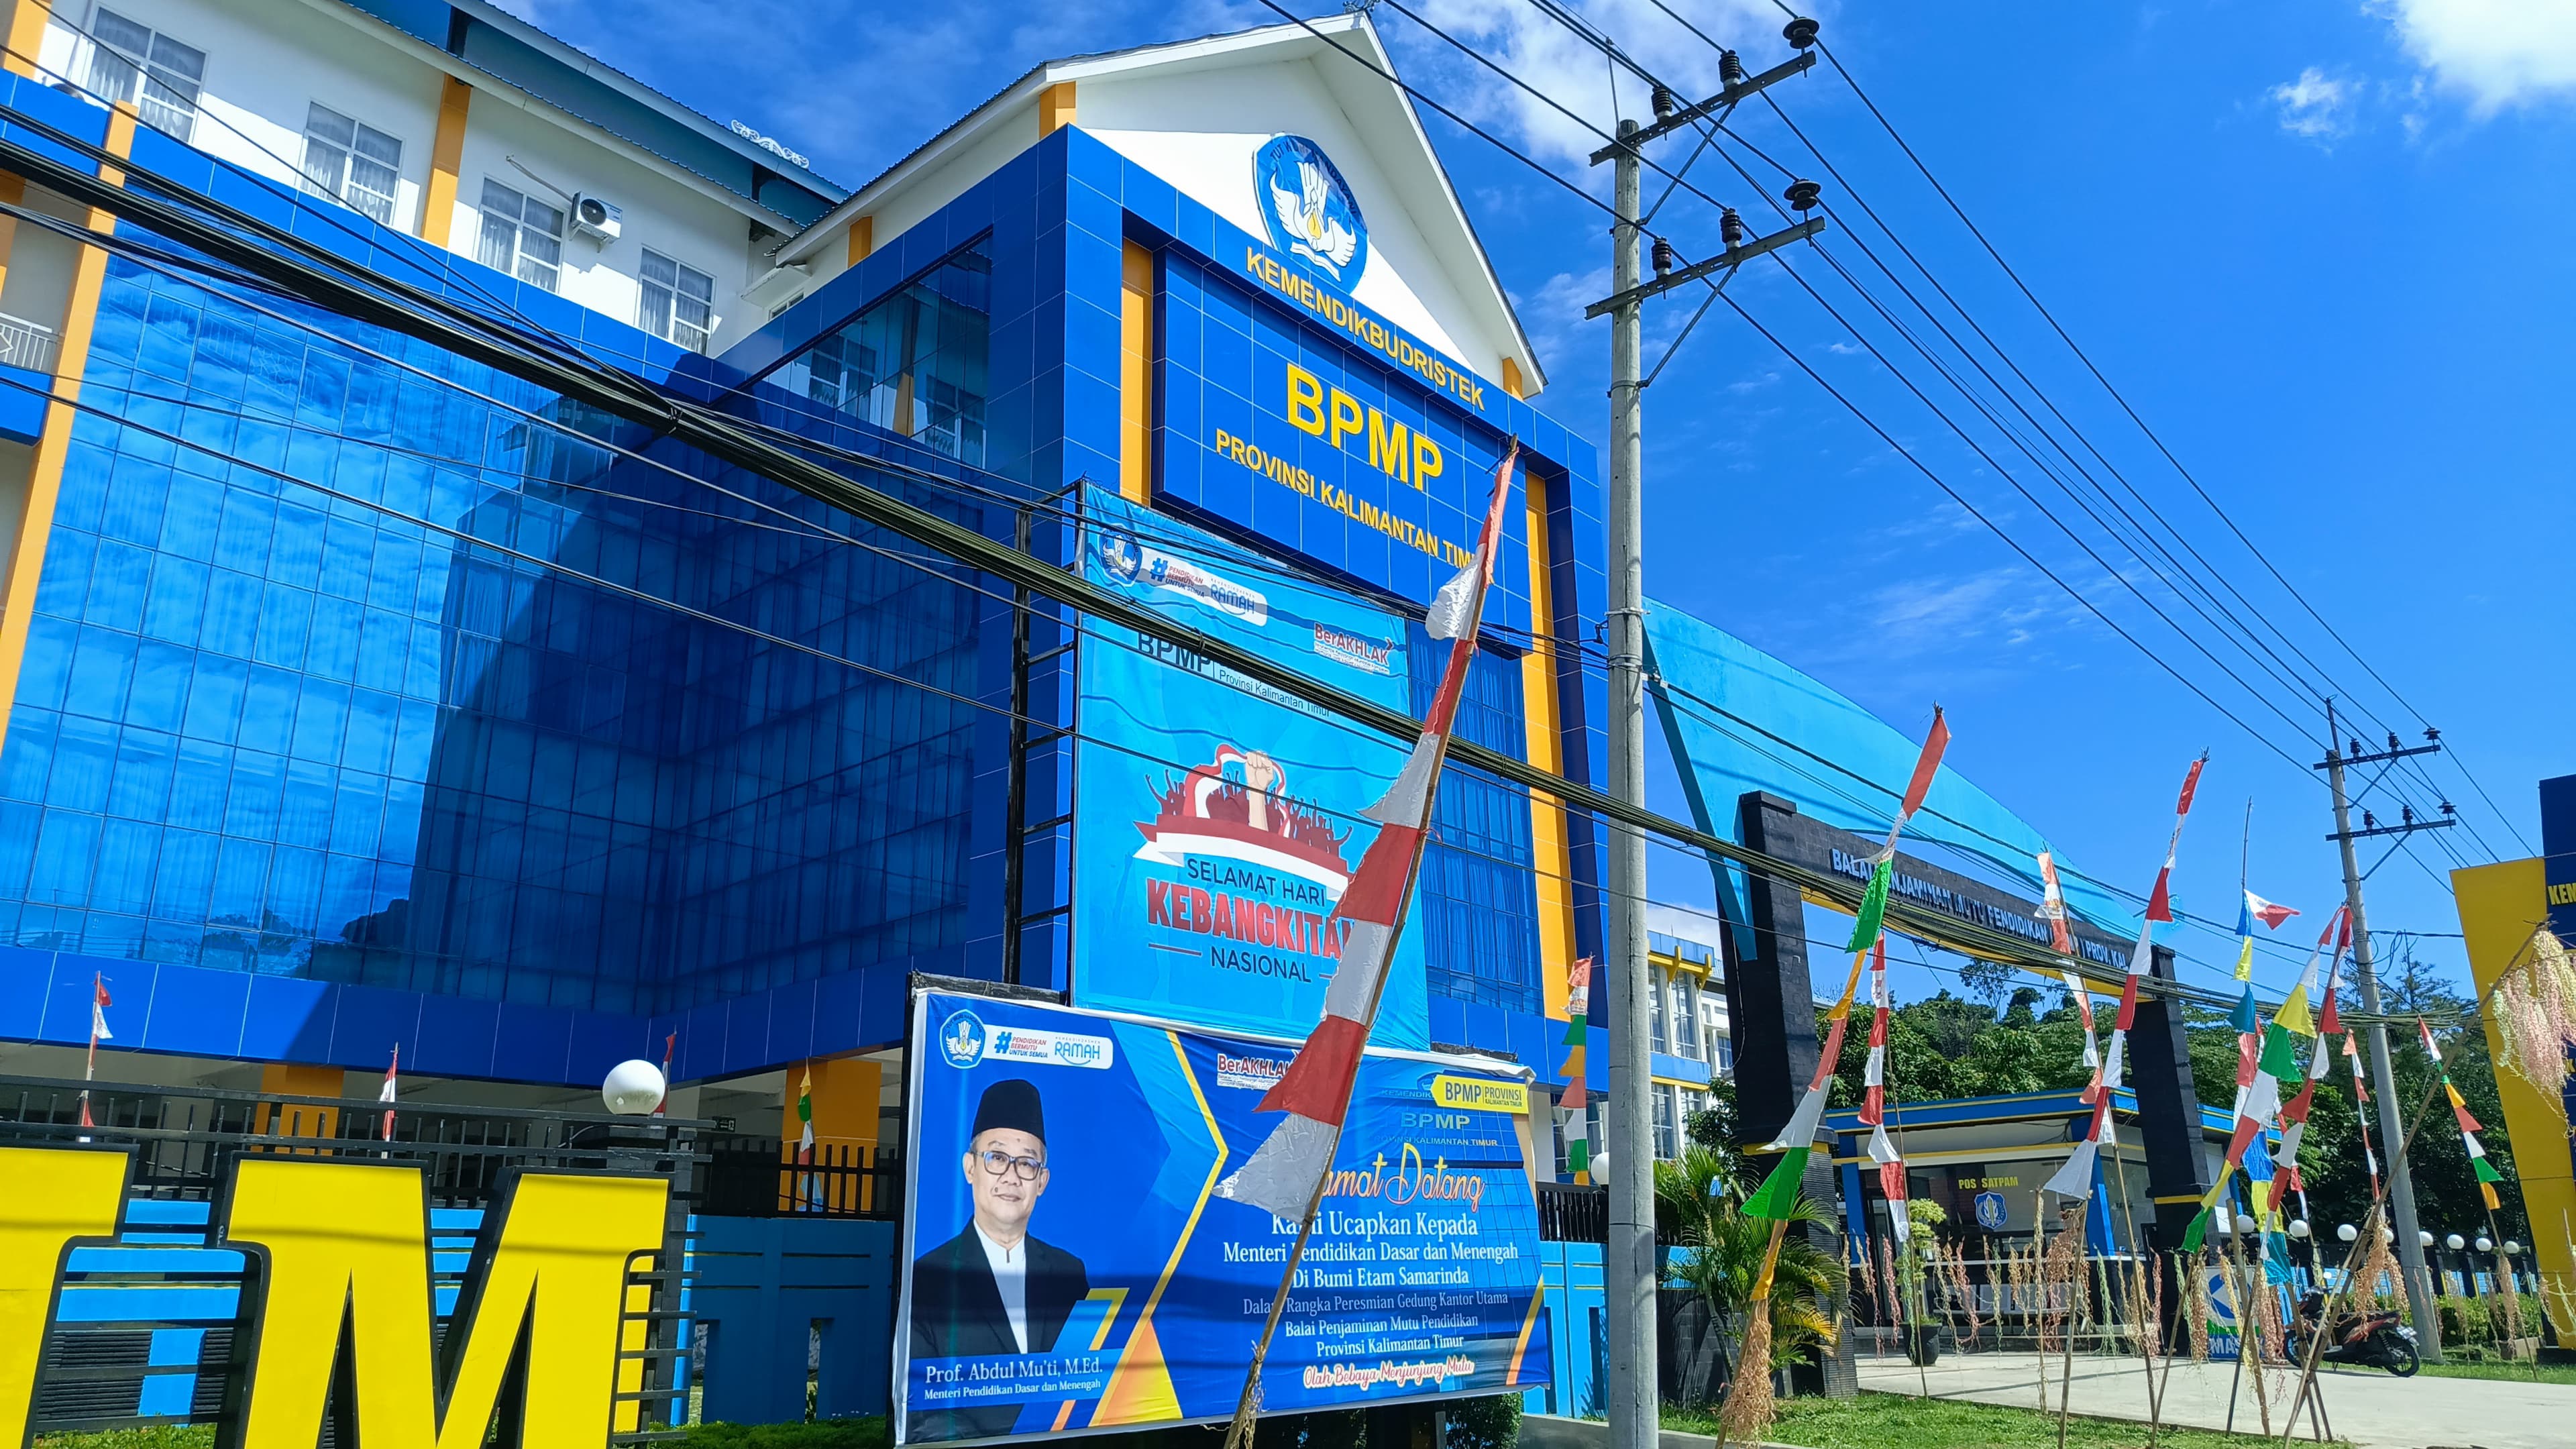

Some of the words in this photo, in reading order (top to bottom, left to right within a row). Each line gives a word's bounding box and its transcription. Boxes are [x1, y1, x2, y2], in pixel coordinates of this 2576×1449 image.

[1246, 246, 1485, 411] KEMENDIKBUDRISTEK
[1287, 363, 1443, 492] BPMP
[1216, 428, 1315, 498] PROVINSI
[1321, 480, 1438, 557] KALIMANTAN
[1165, 578, 1185, 590] UNTUK
[1169, 566, 1203, 584] PENDIDIKAN
[1210, 584, 1255, 615] RAMAH
[1138, 631, 1211, 672] BPMP
[1315, 623, 1389, 666] BerAKHLAK
[1220, 669, 1253, 692] Provinsi
[1255, 680, 1303, 709] Kalimantan
[1187, 858, 1276, 896] SELAMAT
[1282, 879, 1326, 907] HARI
[1987, 904, 2048, 947] PENDIDIKAN
[2085, 940, 2111, 965] PROV.
[1211, 946, 1311, 983] NASIONAL
[1011, 1042, 1037, 1051] BERMUTU
[1012, 1036, 1046, 1045] PENDIDIKAN
[1055, 1041, 1099, 1065] RAMAH
[1381, 1089, 1433, 1099] KEMENDIK
[1446, 1082, 1481, 1104] BPMP
[1485, 1086, 1521, 1101] PROVINSI
[1401, 1112, 1470, 1130] BPMP
[1414, 1138, 1468, 1146] KALIMANTAN
[1470, 1138, 1498, 1146] TIMUR
[1322, 1152, 1385, 1198] amat
[1385, 1142, 1485, 1213] Datang
[1959, 1179, 1977, 1189] POS
[1981, 1176, 2019, 1188] SATPAM
[1329, 1211, 1410, 1242] Ucapkan
[1416, 1212, 1479, 1242] Kepada
[1224, 1242, 1287, 1262] Menteri
[1380, 1242, 1420, 1260] Dasar
[1423, 1242, 1448, 1260] dan
[1450, 1242, 1519, 1265] Menengah
[1292, 1269, 1309, 1288] Di
[1313, 1268, 1353, 1288] Bumi
[1357, 1267, 1395, 1287] Etam
[1399, 1266, 1469, 1285] Samarinda
[1287, 1295, 1332, 1317] Rangka
[1334, 1294, 1395, 1311] Peresmian
[1397, 1293, 1437, 1311] Gedung
[1439, 1291, 1474, 1307] Kantor
[1476, 1291, 1509, 1305] Utama
[1285, 1320, 1316, 1337] Balai
[1319, 1318, 1387, 1339] Penjaminan
[1390, 1316, 1419, 1331] Mutu
[1421, 1312, 1478, 1330] Pendidikan
[1316, 1339, 1365, 1357] Provinsi
[1368, 1336, 1430, 1354] Kalimantan
[1432, 1334, 1464, 1349] Timur
[925, 1363, 964, 1383] Prof.
[969, 1362, 1014, 1381] Abdul
[1065, 1356, 1103, 1374] M.Ed.
[1304, 1364, 1334, 1387] Olah
[1334, 1363, 1377, 1389] Bebaya
[1380, 1360, 1444, 1385] Menjunjung
[1446, 1355, 1473, 1374] Mutu
[924, 1389, 961, 1400] Menteri
[963, 1385, 1013, 1397] Pendidikan
[1015, 1383, 1040, 1393] Dasar
[1042, 1383, 1058, 1391] dan
[1059, 1379, 1101, 1391] Menengah
